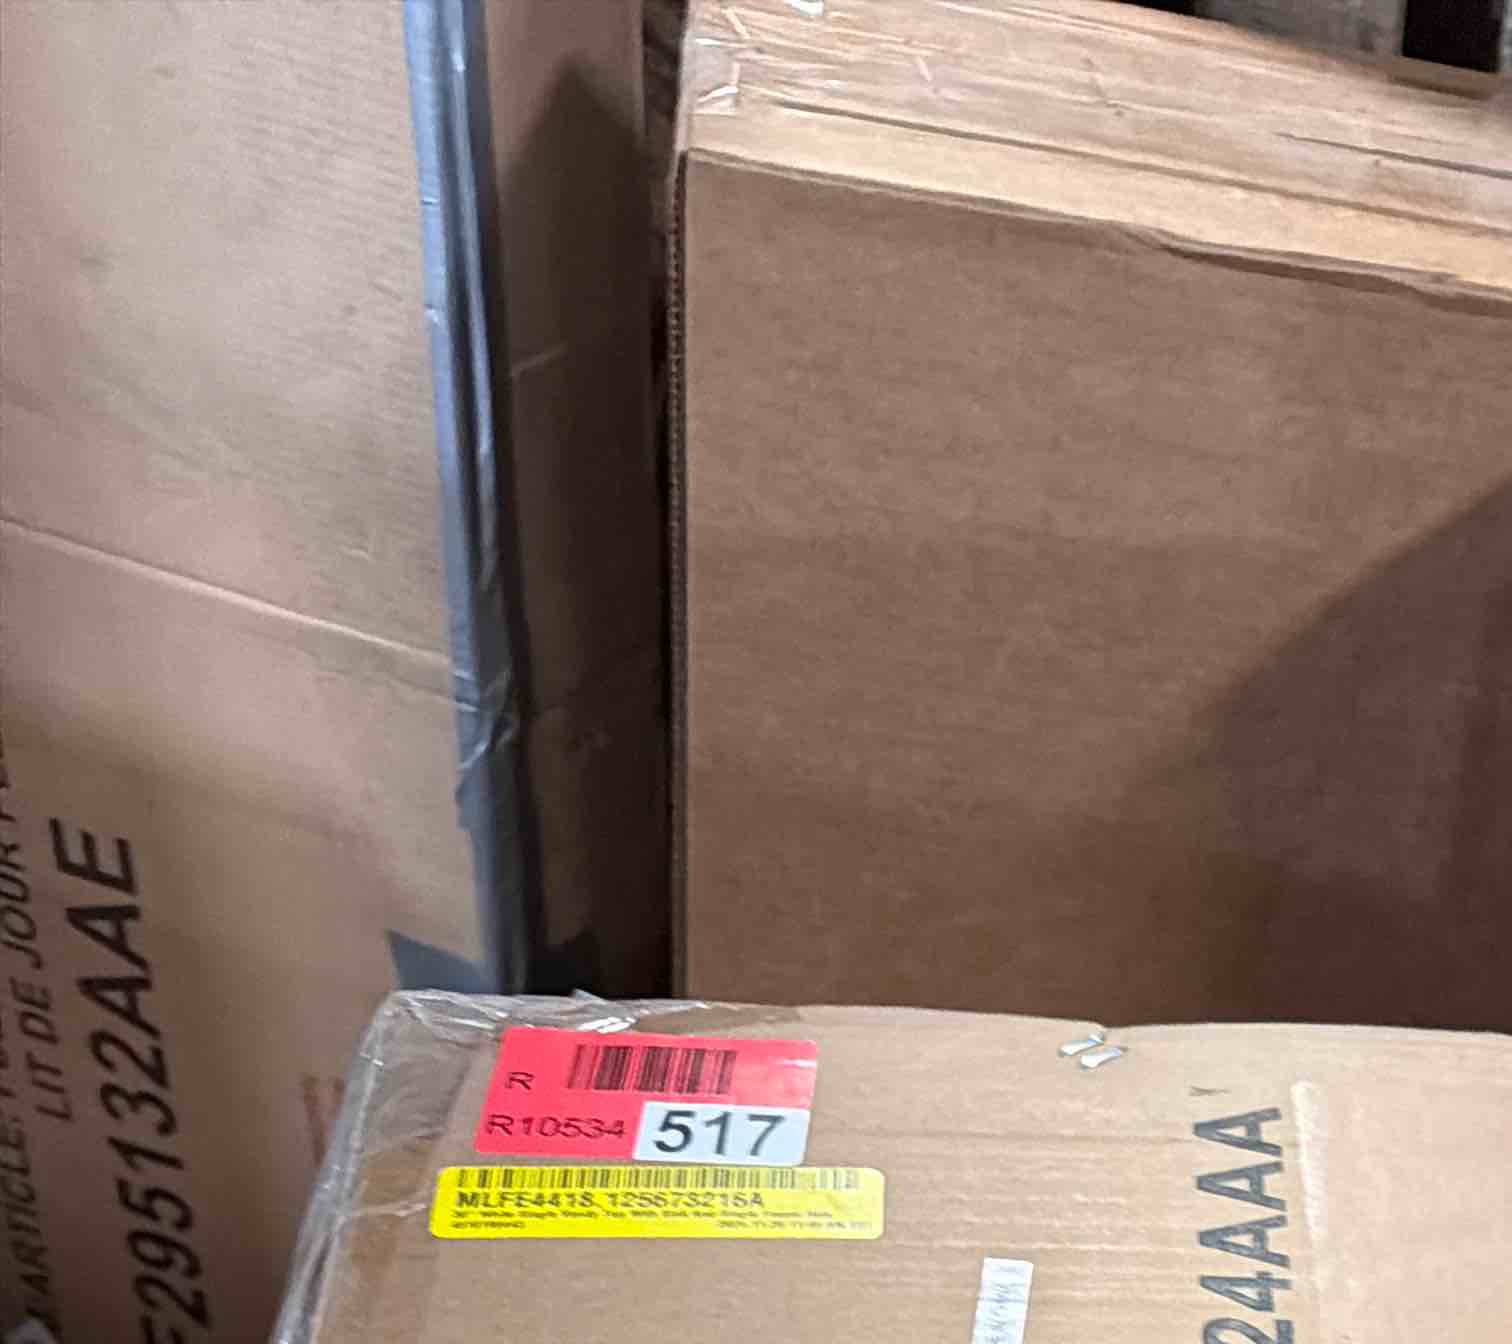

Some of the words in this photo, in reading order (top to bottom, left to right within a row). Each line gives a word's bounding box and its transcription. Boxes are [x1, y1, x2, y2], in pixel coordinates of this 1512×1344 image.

[9, 977, 59, 1044] DE
[26, 1050, 74, 1121] LIT
[505, 1071, 535, 1090] R
[653, 1109, 786, 1156] 517
